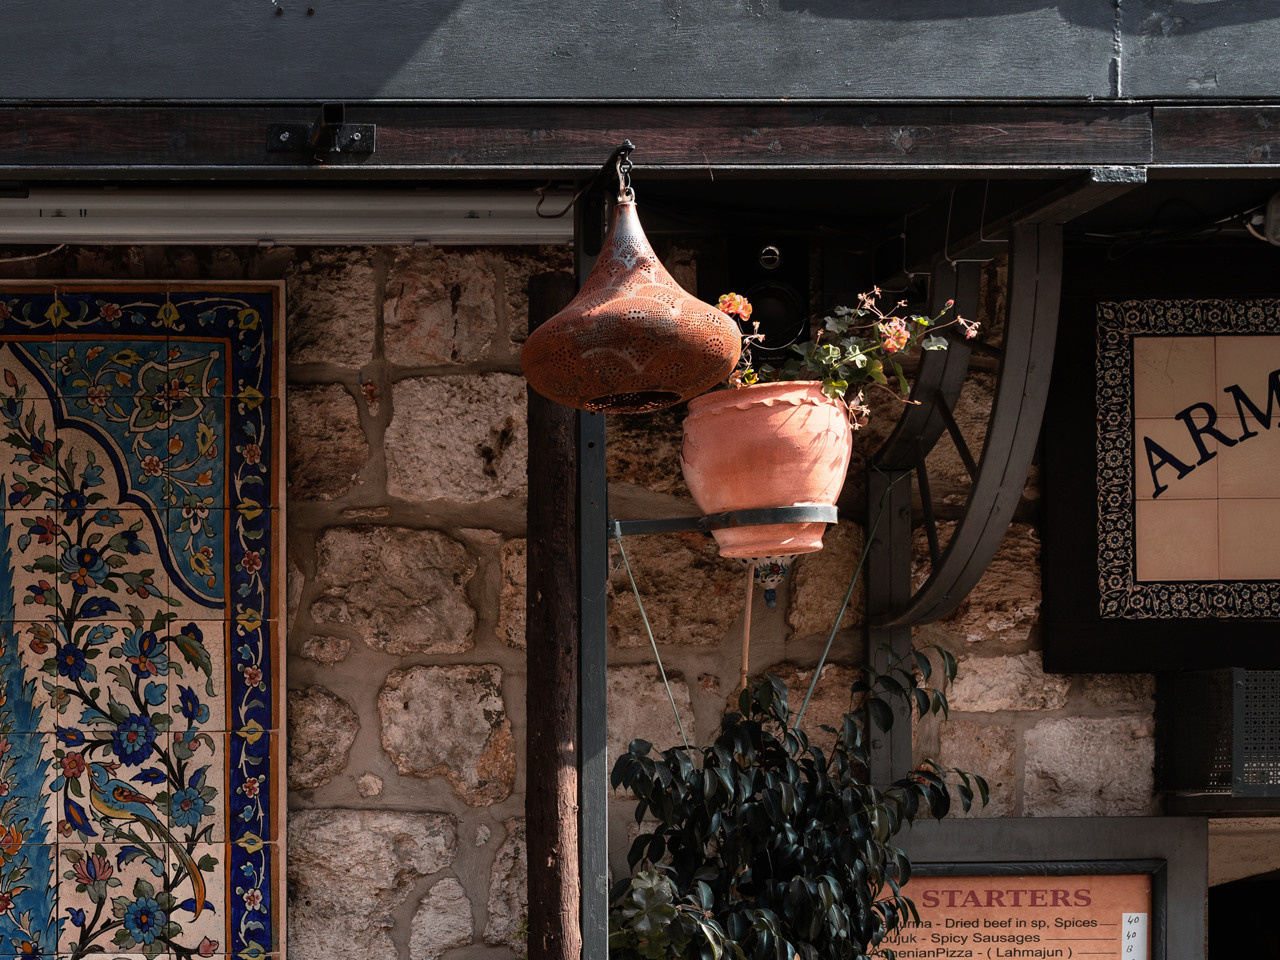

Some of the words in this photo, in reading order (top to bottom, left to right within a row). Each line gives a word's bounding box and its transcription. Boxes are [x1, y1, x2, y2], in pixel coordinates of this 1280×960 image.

[1143, 367, 1280, 499] ARM
[922, 889, 1092, 909] STARTERS
[945, 917, 980, 929] Dried
[983, 917, 1013, 929] beef
[1015, 917, 1027, 928] in
[1030, 919, 1050, 931] sp,
[1054, 917, 1098, 930] Spices
[1127, 915, 1140, 925] 40
[876, 933, 918, 946] oujuk
[930, 932, 969, 946] Spicy
[972, 932, 1041, 946] Sausages
[1126, 930, 1137, 940] 40
[996, 947, 1063, 960] Lahmajun
